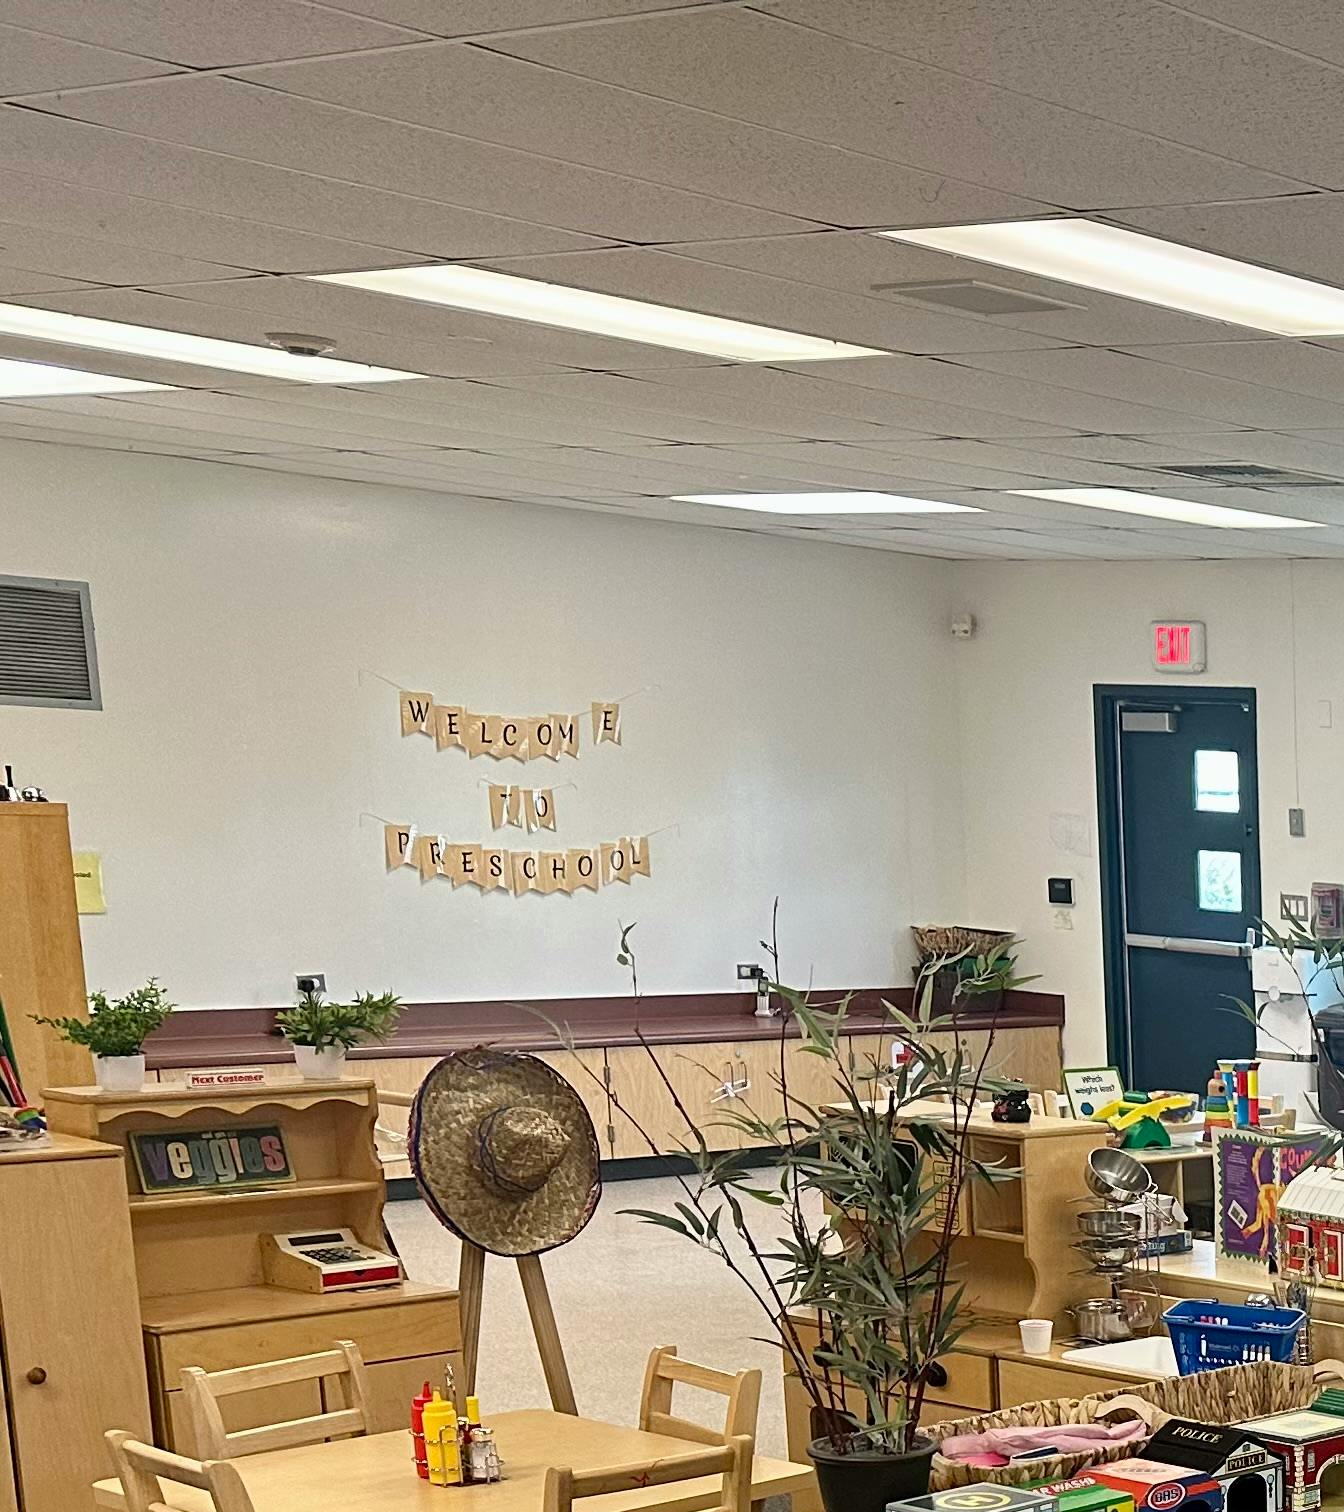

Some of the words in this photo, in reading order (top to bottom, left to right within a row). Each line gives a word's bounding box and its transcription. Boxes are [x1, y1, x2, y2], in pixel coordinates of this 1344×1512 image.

[1155, 626, 1191, 663] EXIT
[407, 699, 614, 746] WELCOME
[397, 831, 642, 880] PRESCHOOL
[191, 1076, 215, 1085] Next
[216, 1074, 265, 1083] Customer
[140, 1134, 287, 1184] veggies
[1171, 1426, 1224, 1444] POLICE
[1228, 1453, 1265, 1470] POLICE
